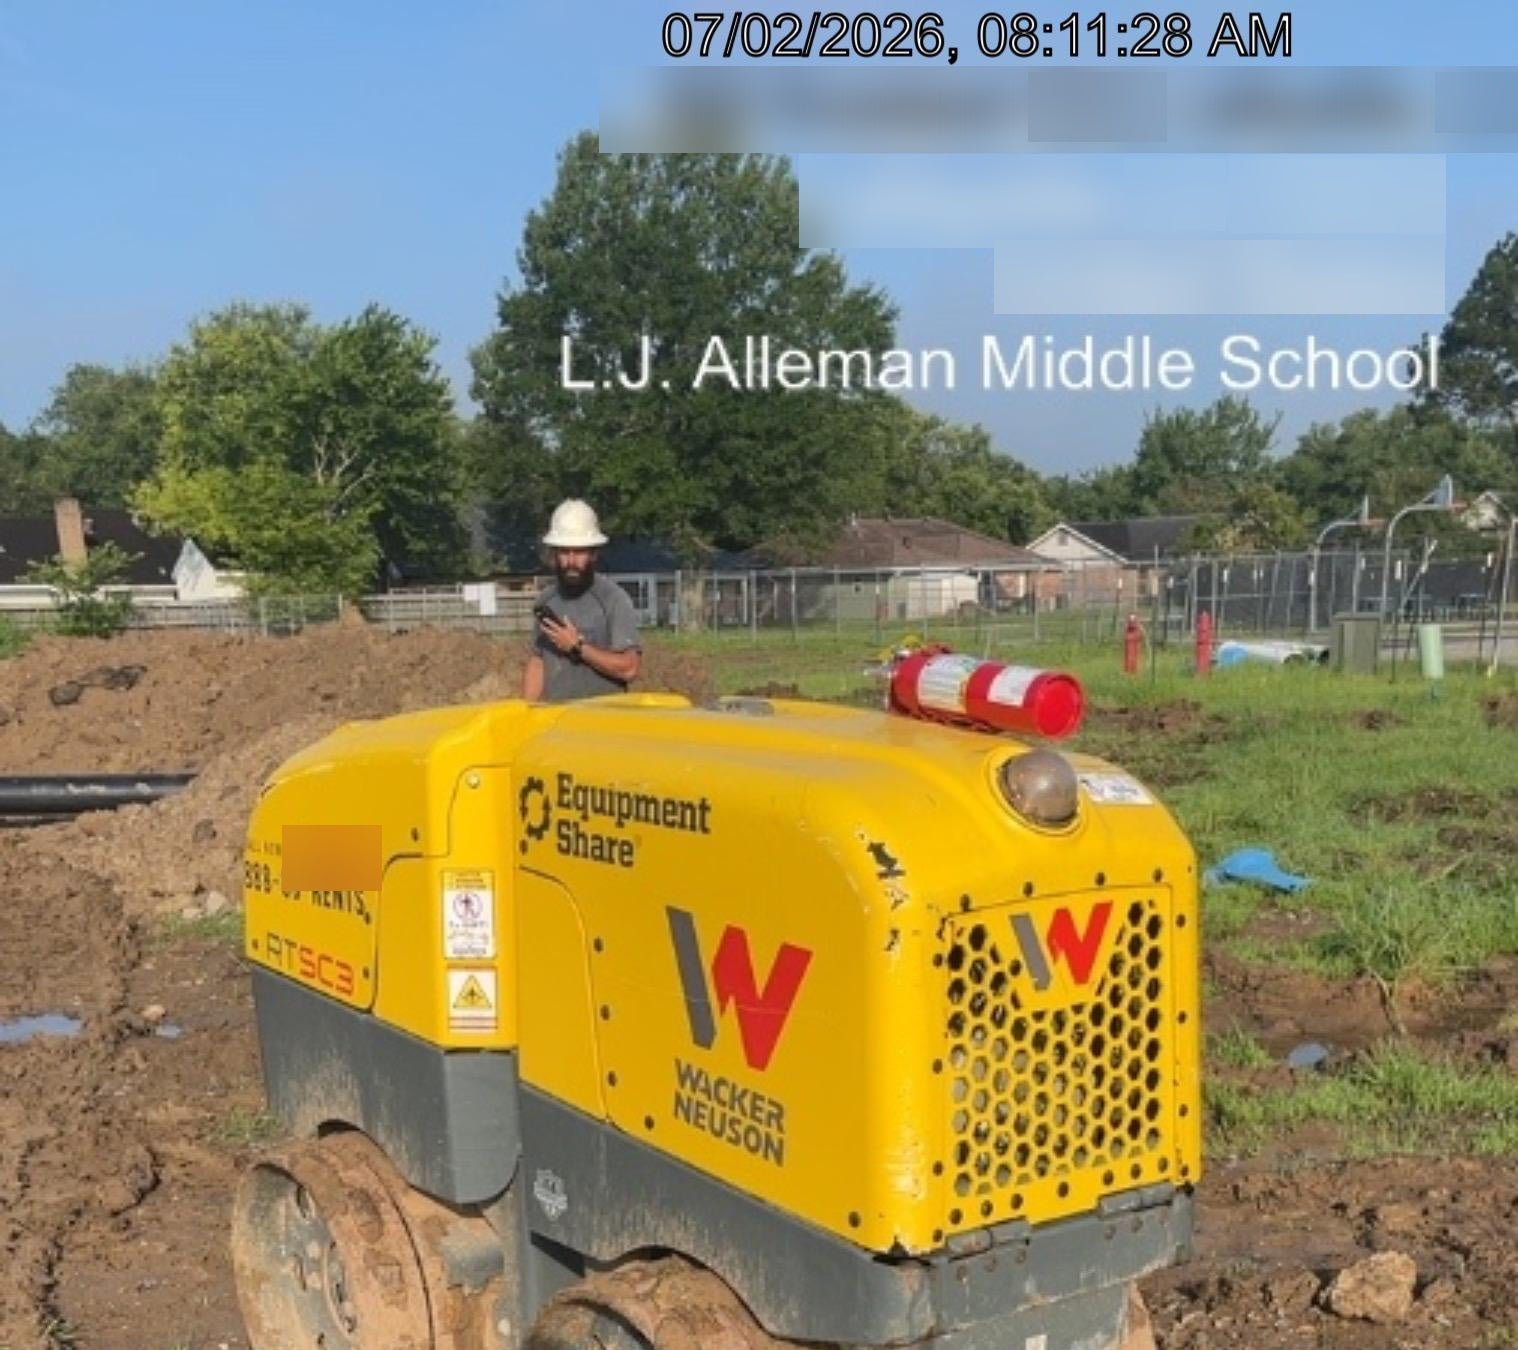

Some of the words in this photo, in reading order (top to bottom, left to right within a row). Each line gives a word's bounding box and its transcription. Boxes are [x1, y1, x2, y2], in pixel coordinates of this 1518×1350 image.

[557, 773, 711, 834] Equipment
[557, 819, 634, 867] Share
[674, 1092, 783, 1167] NEUSON
[675, 1058, 784, 1133] WACKER
